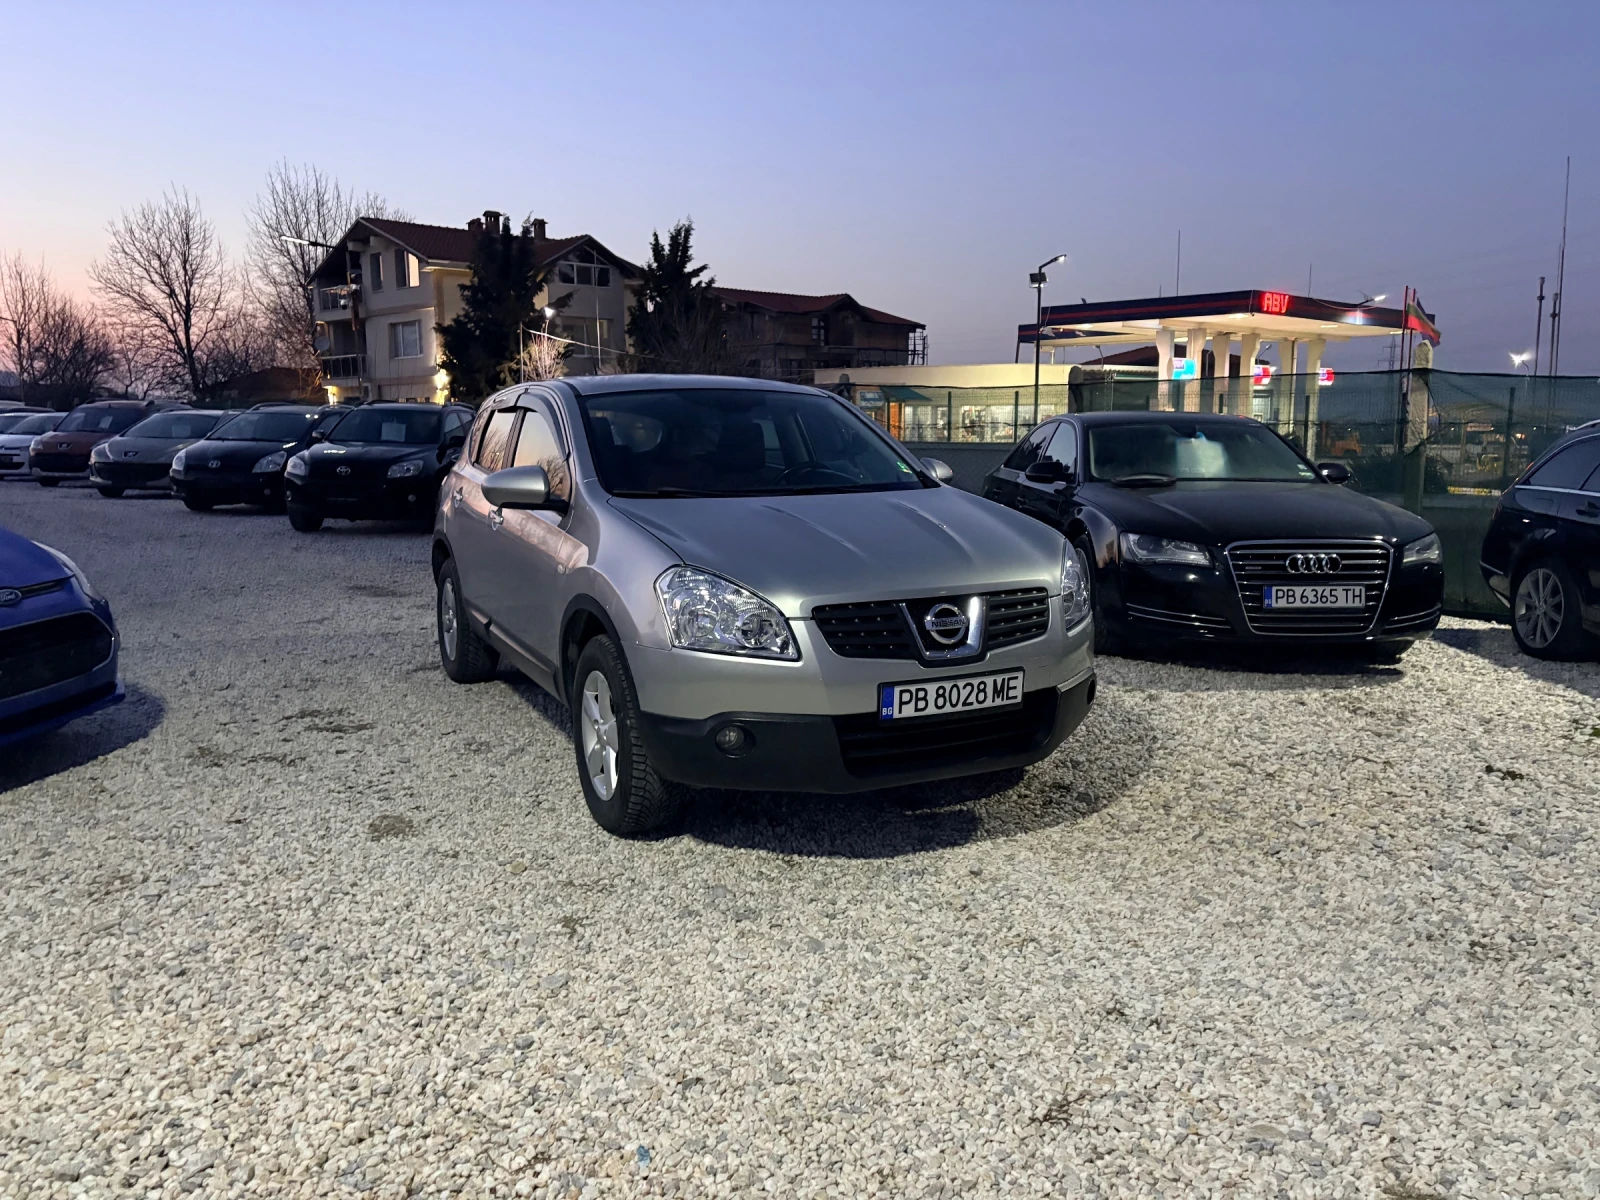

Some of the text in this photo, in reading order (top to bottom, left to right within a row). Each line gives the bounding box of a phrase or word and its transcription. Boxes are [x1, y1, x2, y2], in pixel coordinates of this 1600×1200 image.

[1263, 292, 1289, 313] ABV
[1275, 588, 1362, 604] PB 6365 TH
[931, 619, 966, 628] NISSAN
[898, 676, 1019, 714] PB 8028 ME
[882, 707, 893, 715] BG
